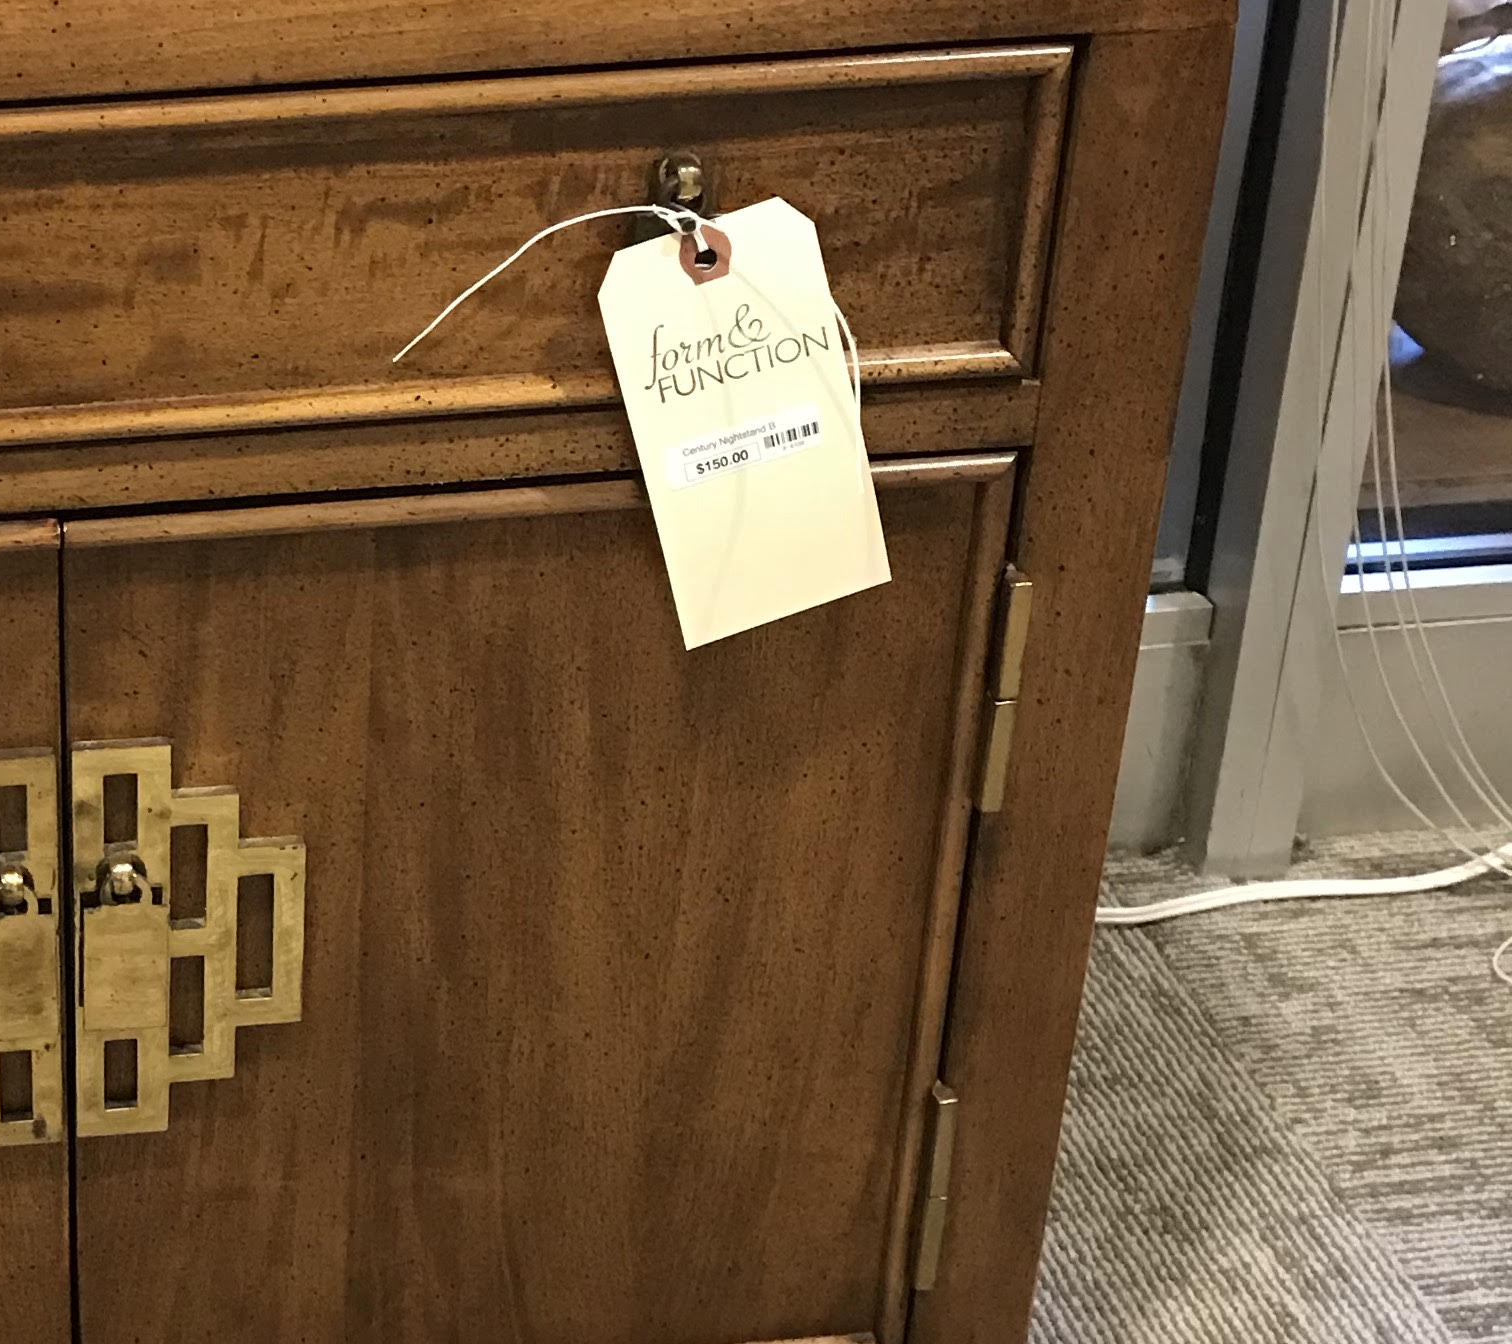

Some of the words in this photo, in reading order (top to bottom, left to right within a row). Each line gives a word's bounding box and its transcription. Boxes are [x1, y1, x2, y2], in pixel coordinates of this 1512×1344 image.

[658, 326, 829, 404] FUNCTION
[682, 441, 717, 457] Century
[718, 424, 767, 446] Nightstand
[696, 449, 749, 475] $150.00
